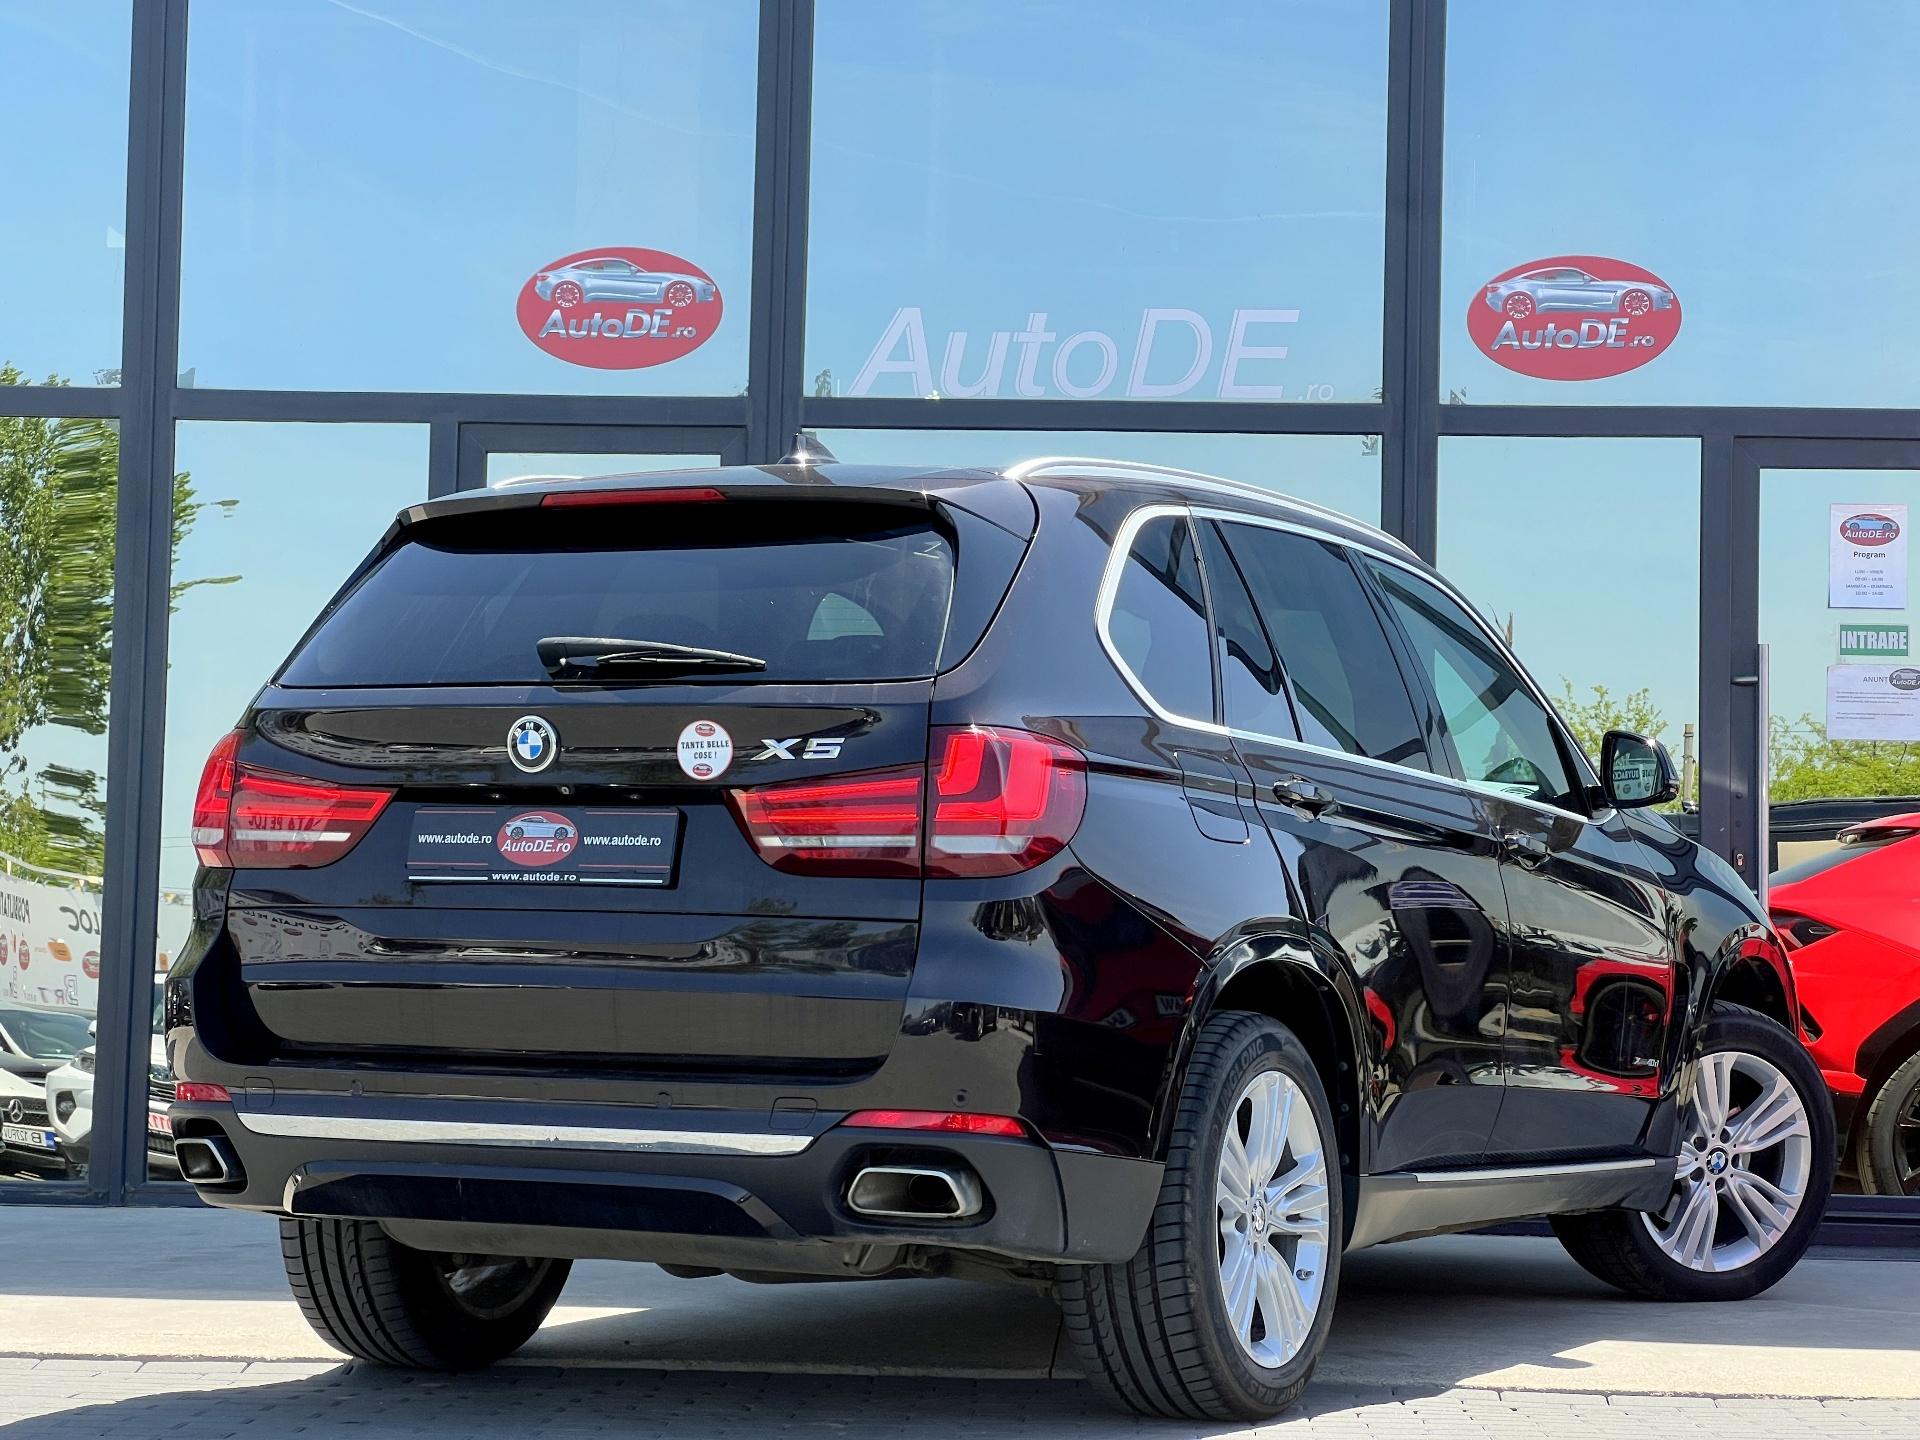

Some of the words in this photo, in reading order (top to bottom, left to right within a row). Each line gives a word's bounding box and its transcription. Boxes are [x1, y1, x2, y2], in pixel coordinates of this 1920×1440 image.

[1844, 529, 1896, 539] AutoDE.ro
[1853, 551, 1886, 559] Program
[1840, 630, 1907, 650] INTRARE
[513, 721, 547, 738] BMW
[681, 741, 705, 749] TANTE
[707, 740, 729, 748] BELLE
[750, 738, 846, 760] X5
[693, 751, 712, 760] COSE
[417, 832, 492, 845] www.autode.ro
[583, 834, 662, 847] www.autode.ro
[500, 839, 571, 853] AutoDE.ro
[491, 871, 577, 882] www.autode.ro
